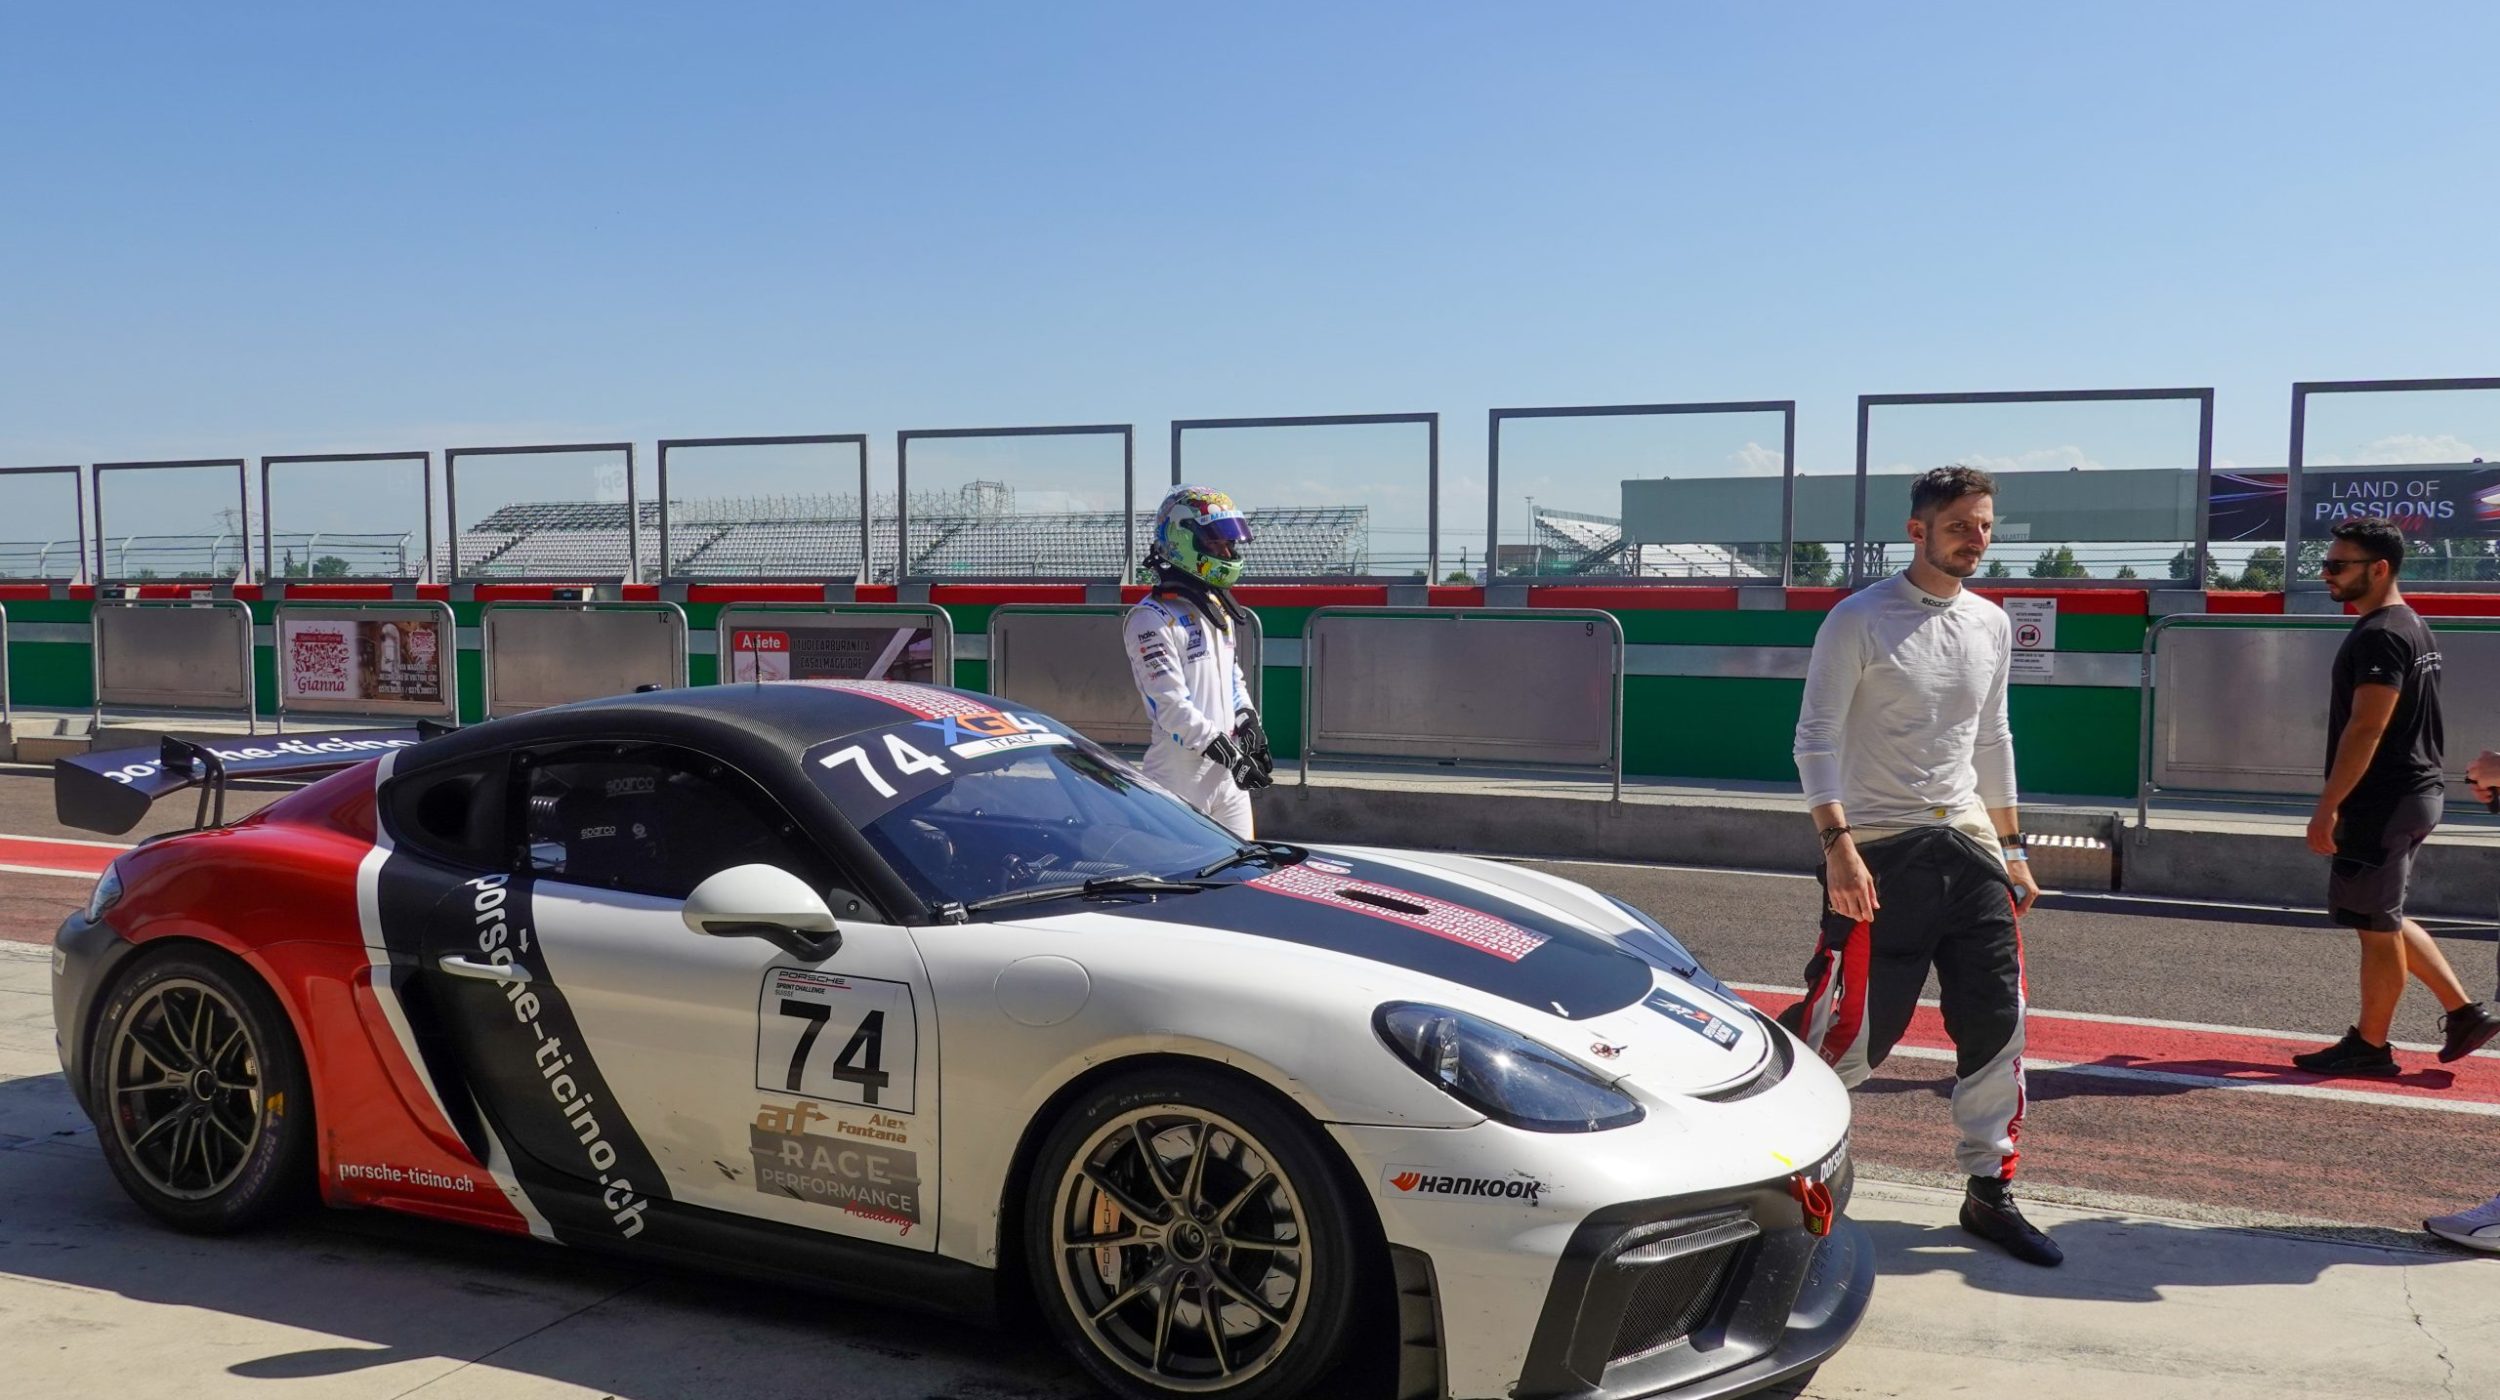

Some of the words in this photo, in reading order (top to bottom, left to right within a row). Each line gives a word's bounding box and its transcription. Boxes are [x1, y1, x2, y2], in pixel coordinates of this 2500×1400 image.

[2332, 481, 2398, 498] LAND
[2407, 480, 2440, 497] OF
[2315, 501, 2454, 520] PASSIONS
[658, 612, 669, 623] 12
[1586, 622, 1594, 636] 9
[298, 676, 345, 694] Gianna
[985, 735, 1035, 748] ITALY
[103, 735, 418, 784] ohe-ticino
[819, 734, 951, 798] 74
[606, 776, 655, 795] sparco
[581, 825, 616, 838] sparco
[779, 971, 846, 985] PORSCHE
[776, 982, 795, 991] SPRINT
[795, 985, 826, 995] CHALLENGE
[780, 999, 889, 1105] 74
[869, 1113, 909, 1130] Alex
[837, 1120, 907, 1144] Fontana
[780, 1140, 891, 1184] RACE
[339, 1163, 474, 1192] porsche-ticino.ch
[762, 1168, 912, 1213] PERFORMANCE
